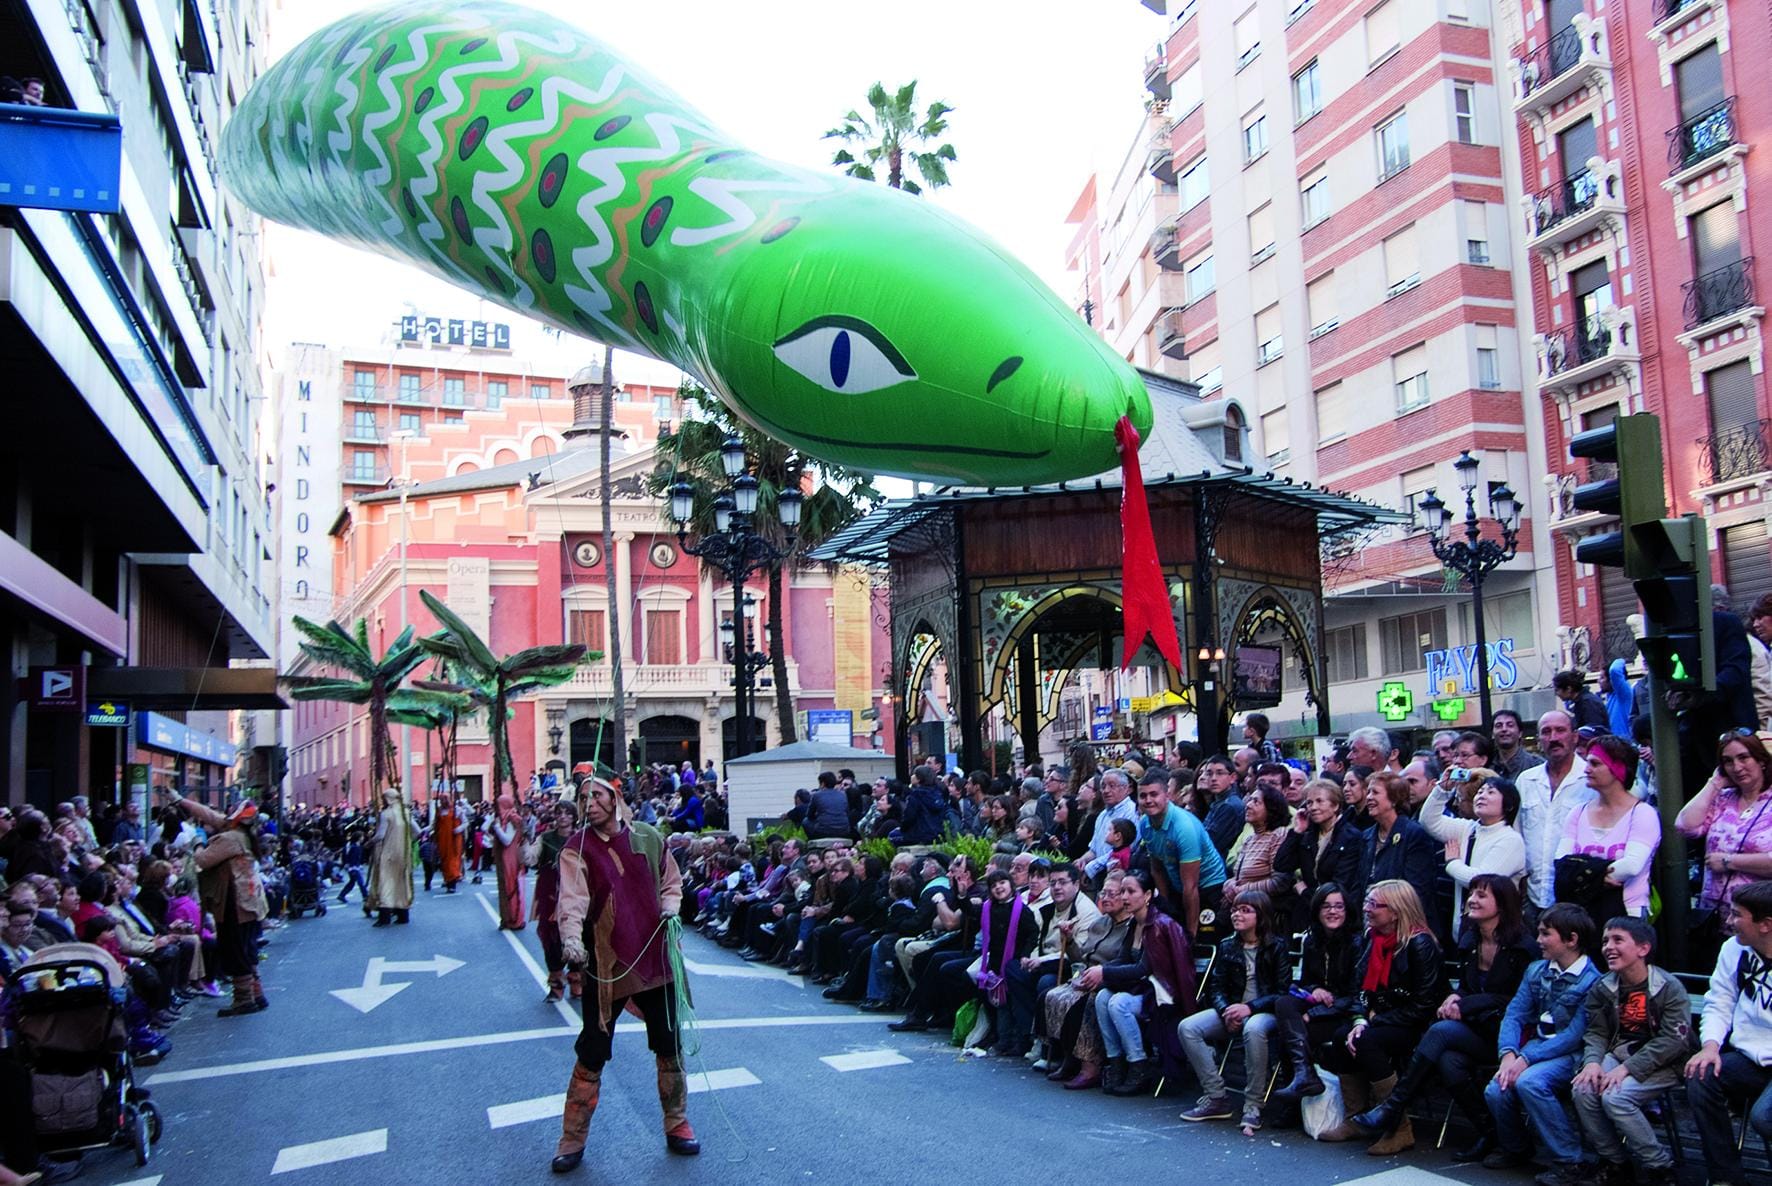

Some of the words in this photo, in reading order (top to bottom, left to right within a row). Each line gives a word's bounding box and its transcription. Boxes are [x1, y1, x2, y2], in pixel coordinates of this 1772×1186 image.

[402, 318, 509, 344] HOTEL
[296, 379, 312, 601] MINDORO
[616, 512, 657, 521] TEATRO
